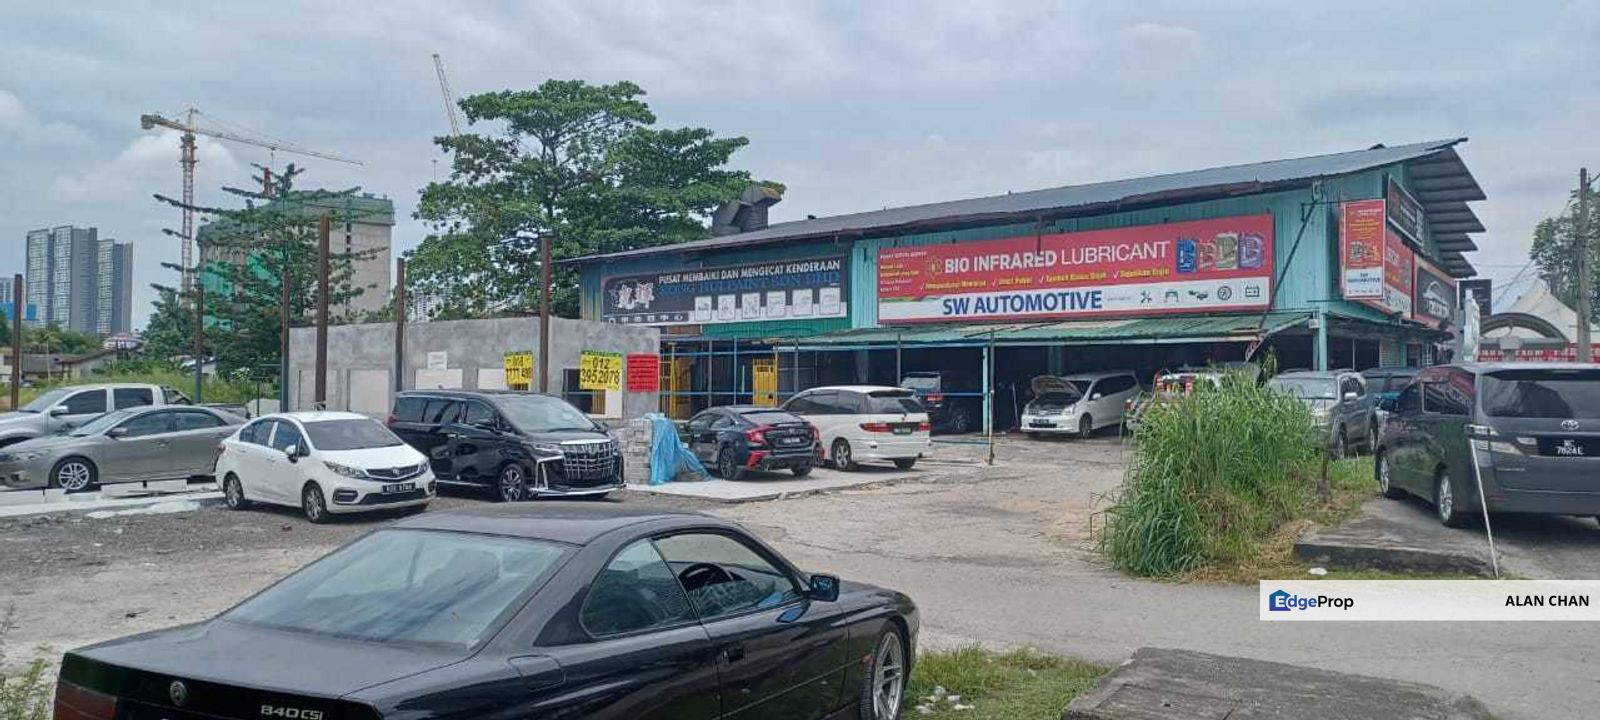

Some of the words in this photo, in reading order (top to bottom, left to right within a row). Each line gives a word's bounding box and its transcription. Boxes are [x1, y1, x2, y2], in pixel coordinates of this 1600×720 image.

[944, 258, 970, 274] BIO
[973, 250, 1057, 272] INFRARED
[1061, 240, 1171, 265] LUBRICANT
[658, 273, 681, 285] PUSAT
[721, 269, 739, 280] DAN
[740, 264, 784, 278] MENGECAT
[786, 259, 840, 274] KENDERAAN
[943, 297, 970, 316] SW
[974, 290, 1103, 314] AUTOMOTIVE
[592, 357, 610, 370] 012
